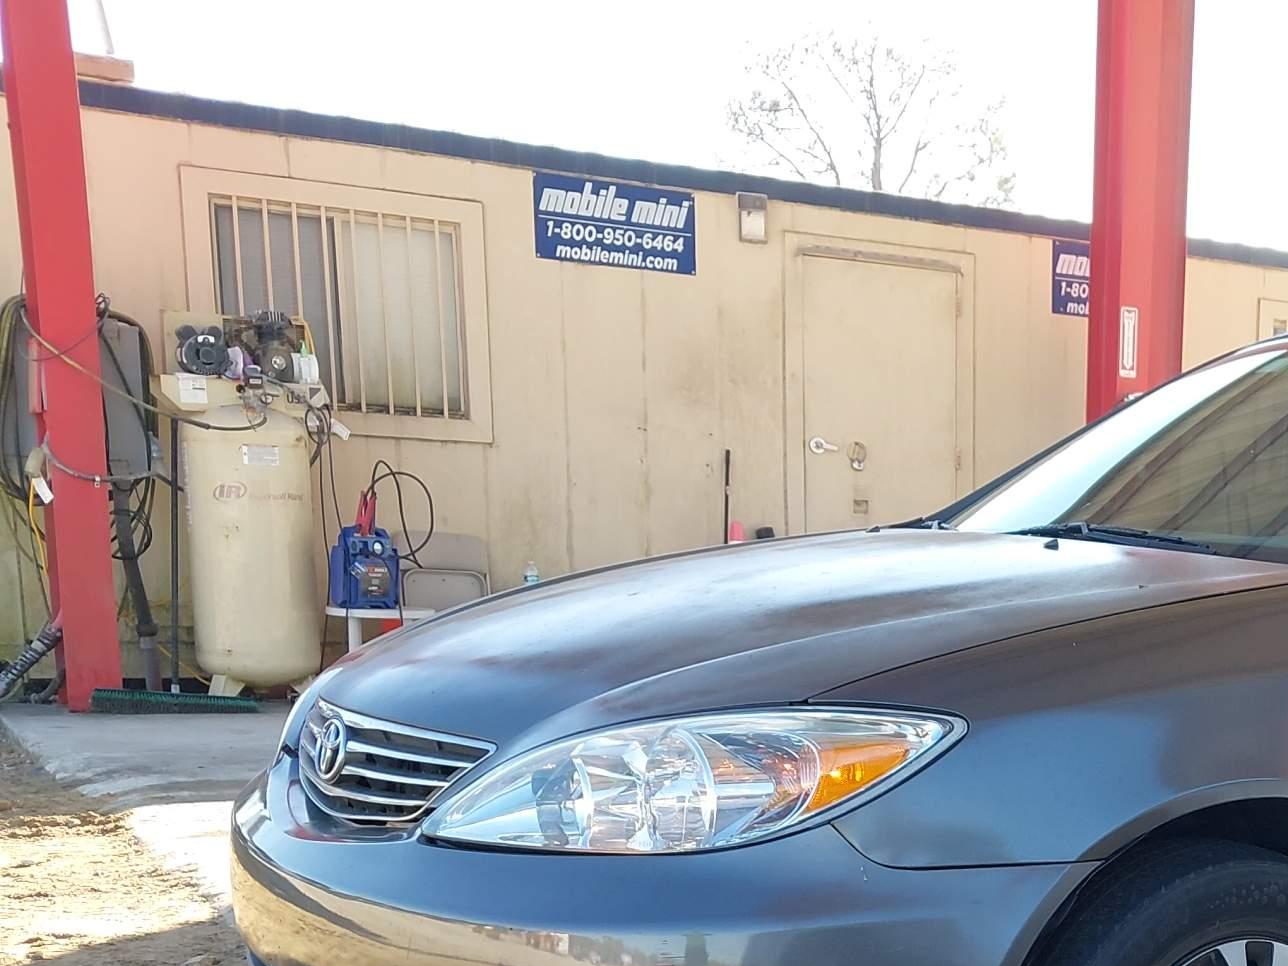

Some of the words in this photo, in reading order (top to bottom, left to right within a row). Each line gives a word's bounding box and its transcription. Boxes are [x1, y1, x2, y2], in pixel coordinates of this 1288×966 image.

[538, 181, 629, 221] mobile
[630, 198, 690, 229] mini
[546, 220, 684, 253] 1-800-950-6464
[556, 244, 678, 271] mobilemini.com
